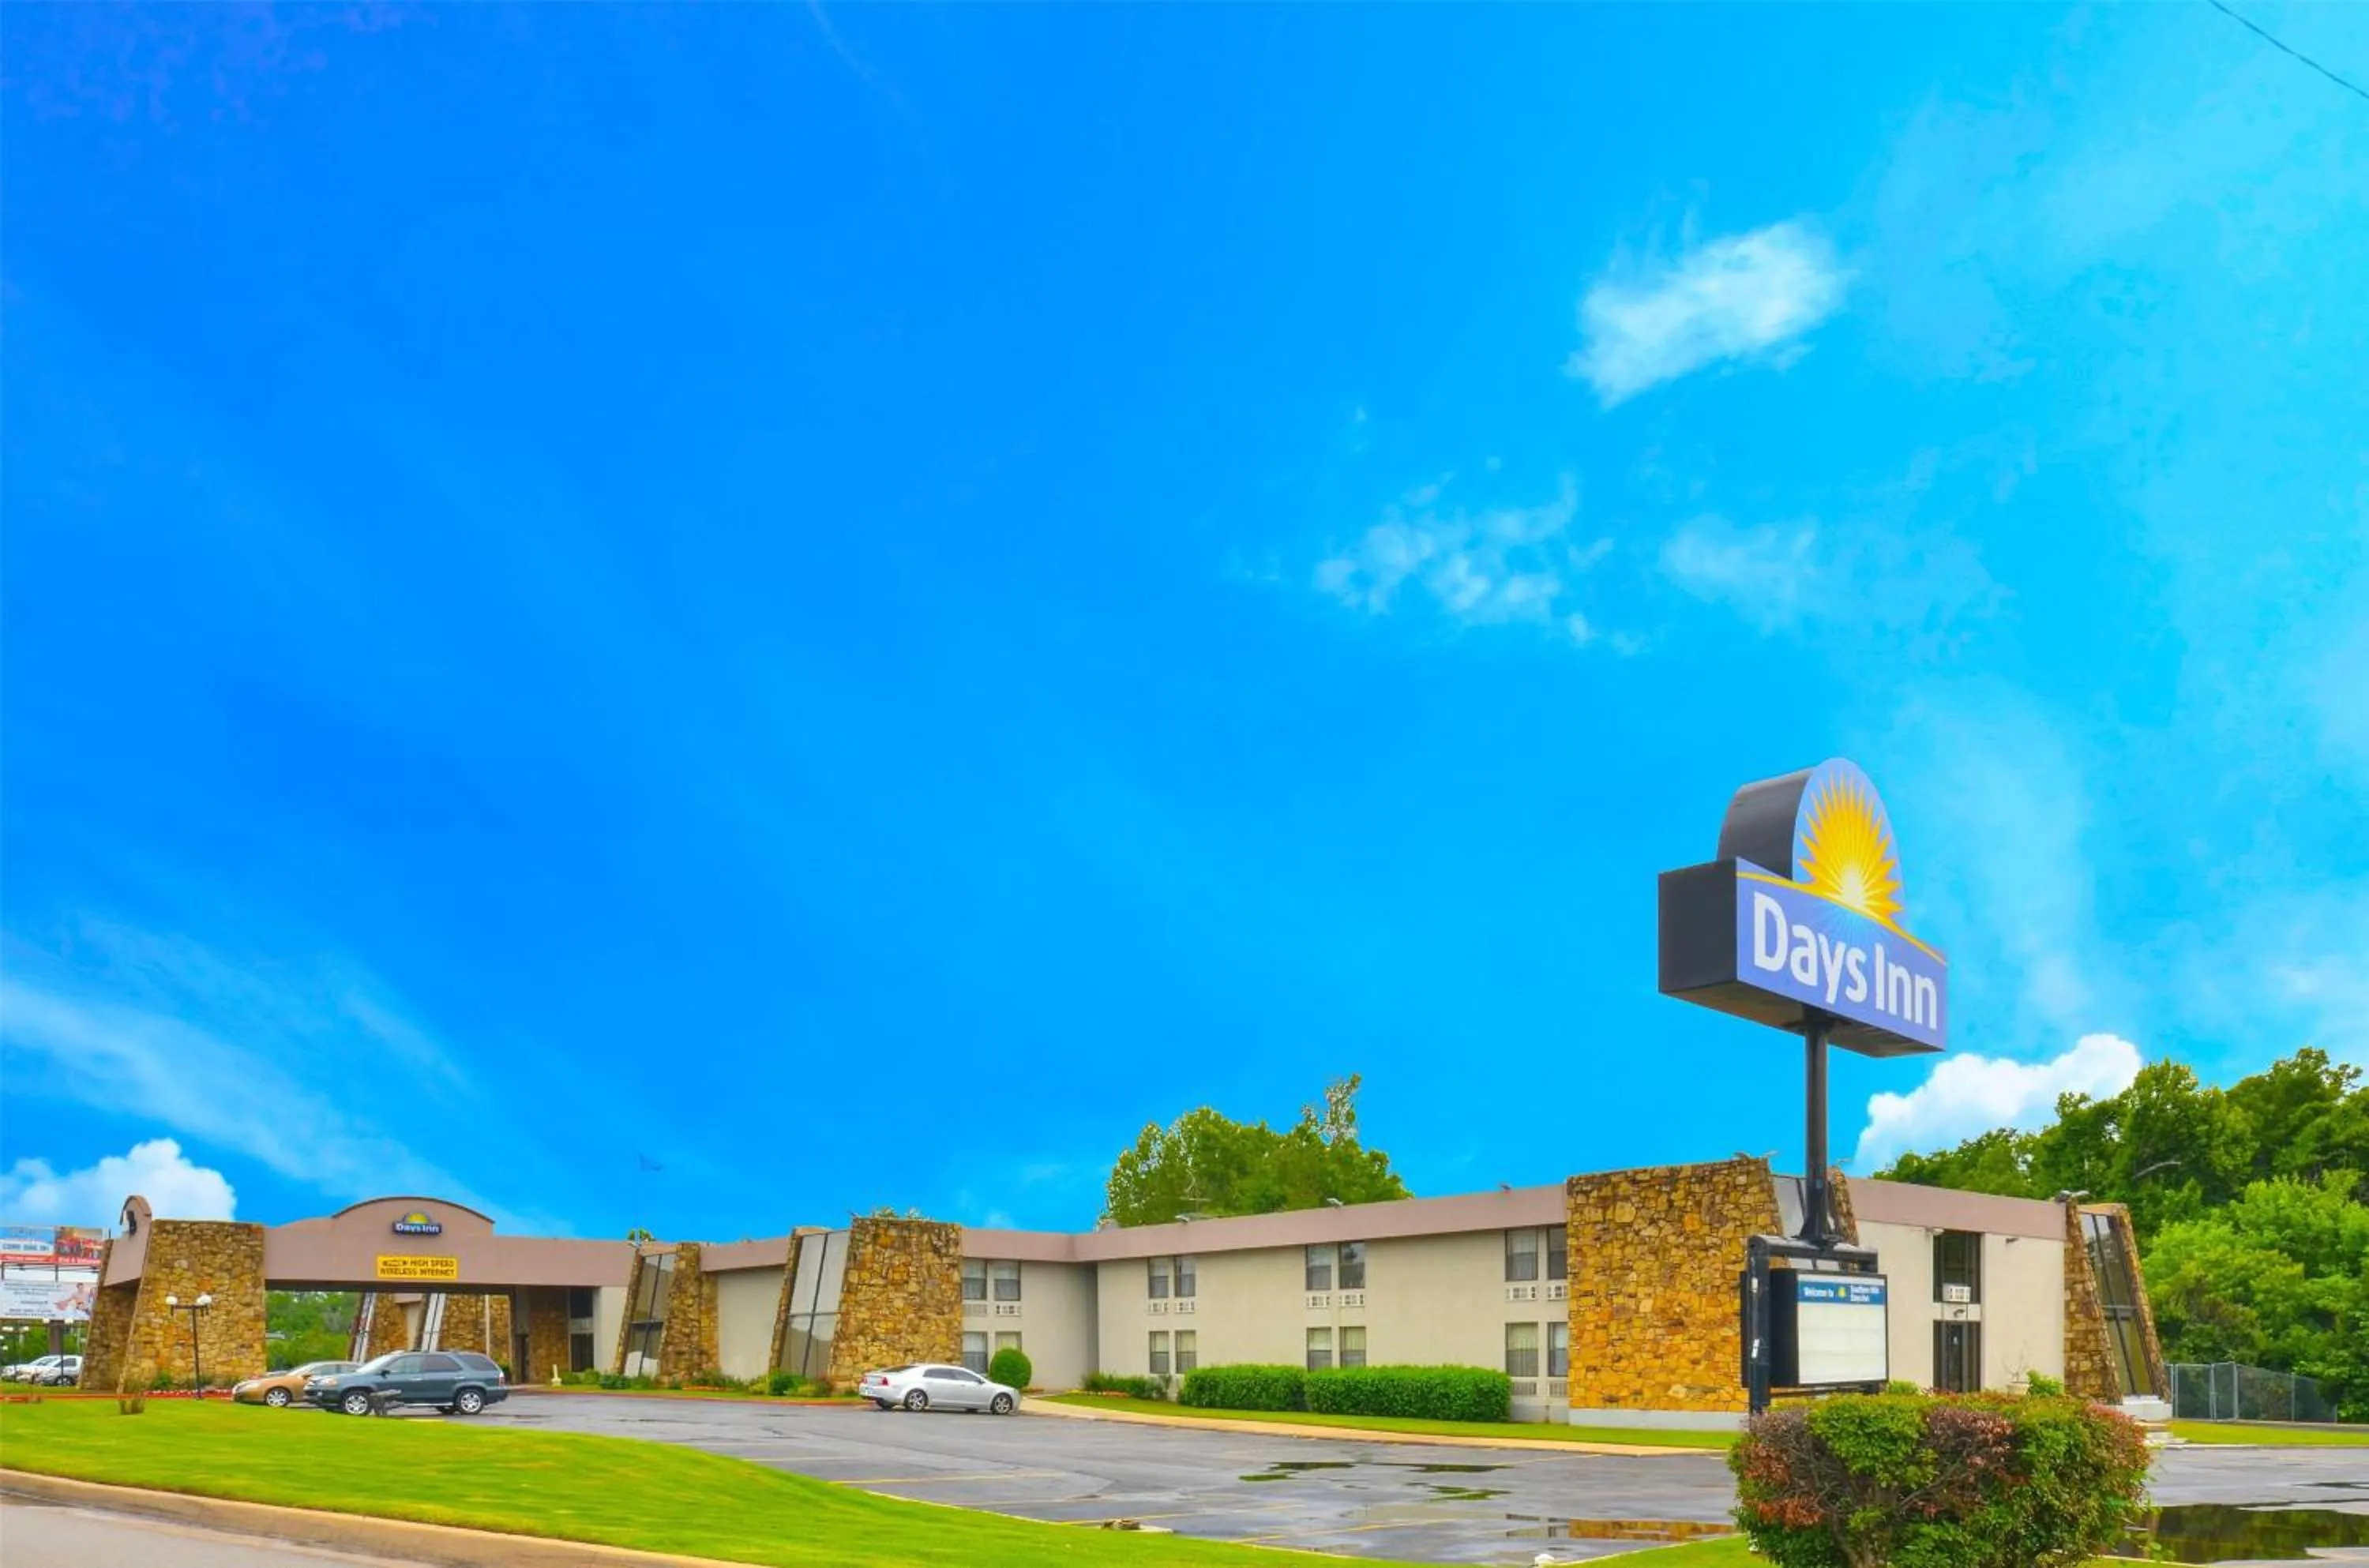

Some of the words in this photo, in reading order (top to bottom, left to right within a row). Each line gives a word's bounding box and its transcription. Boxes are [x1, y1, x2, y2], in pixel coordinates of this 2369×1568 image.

[1753, 890, 1868, 1005] Days
[1875, 942, 1937, 1030] Inn
[396, 1223, 421, 1232] Days
[422, 1224, 440, 1232] Inn
[380, 1267, 417, 1276] WIRELESS
[419, 1268, 455, 1277] INTERNET
[1803, 1286, 1826, 1297] Welcome
[1828, 1288, 1834, 1297] to
